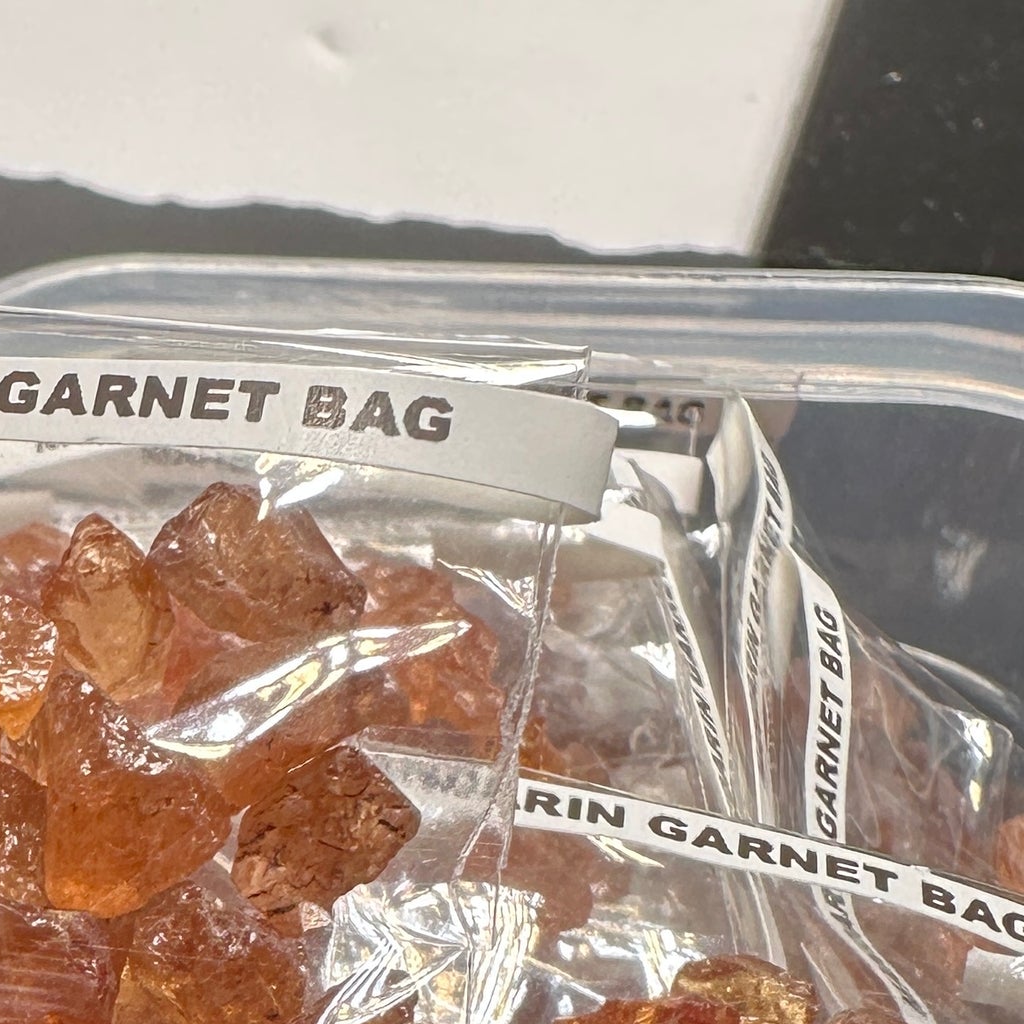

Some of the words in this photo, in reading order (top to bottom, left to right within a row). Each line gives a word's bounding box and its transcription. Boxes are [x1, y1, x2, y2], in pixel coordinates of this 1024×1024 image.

[302, 384, 454, 442] BAG
[814, 601, 845, 680] BAG
[815, 678, 844, 839] GARNET
[515, 788, 625, 828] RIN
[648, 813, 899, 892] GARNET
